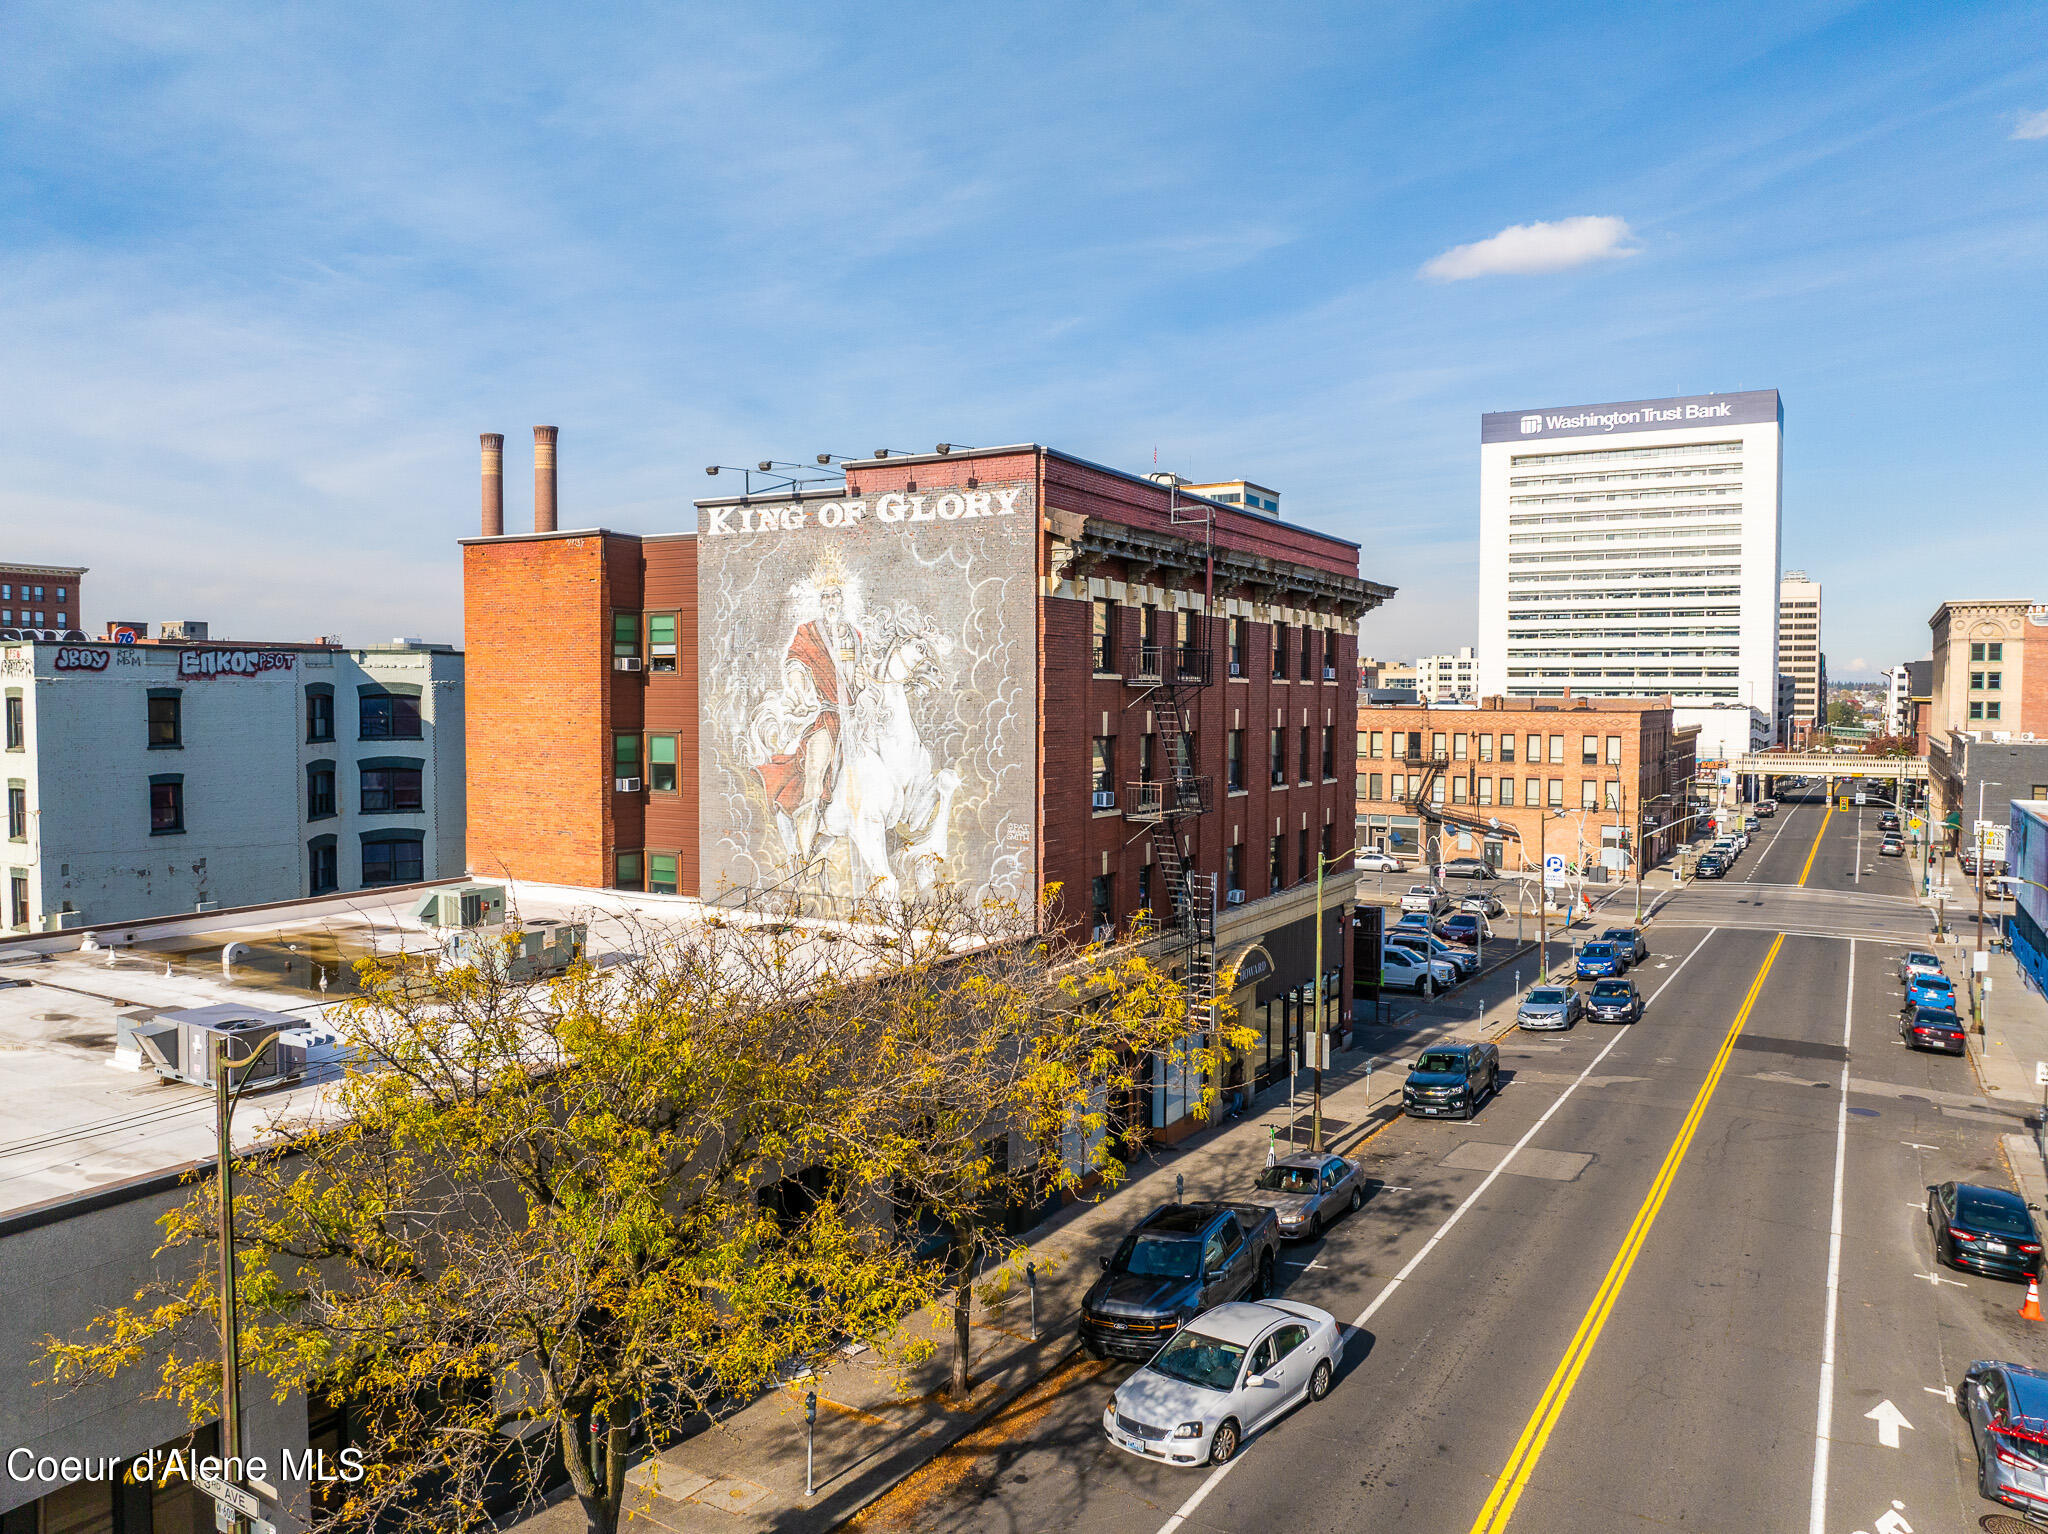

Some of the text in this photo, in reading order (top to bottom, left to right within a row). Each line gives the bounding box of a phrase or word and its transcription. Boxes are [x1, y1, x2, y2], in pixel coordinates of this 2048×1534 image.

[1546, 402, 1732, 431] Washington Trust Bank
[706, 488, 1023, 535] KING OF GLORY
[118, 631, 135, 644] 76
[1240, 960, 1266, 982] HOWARD
